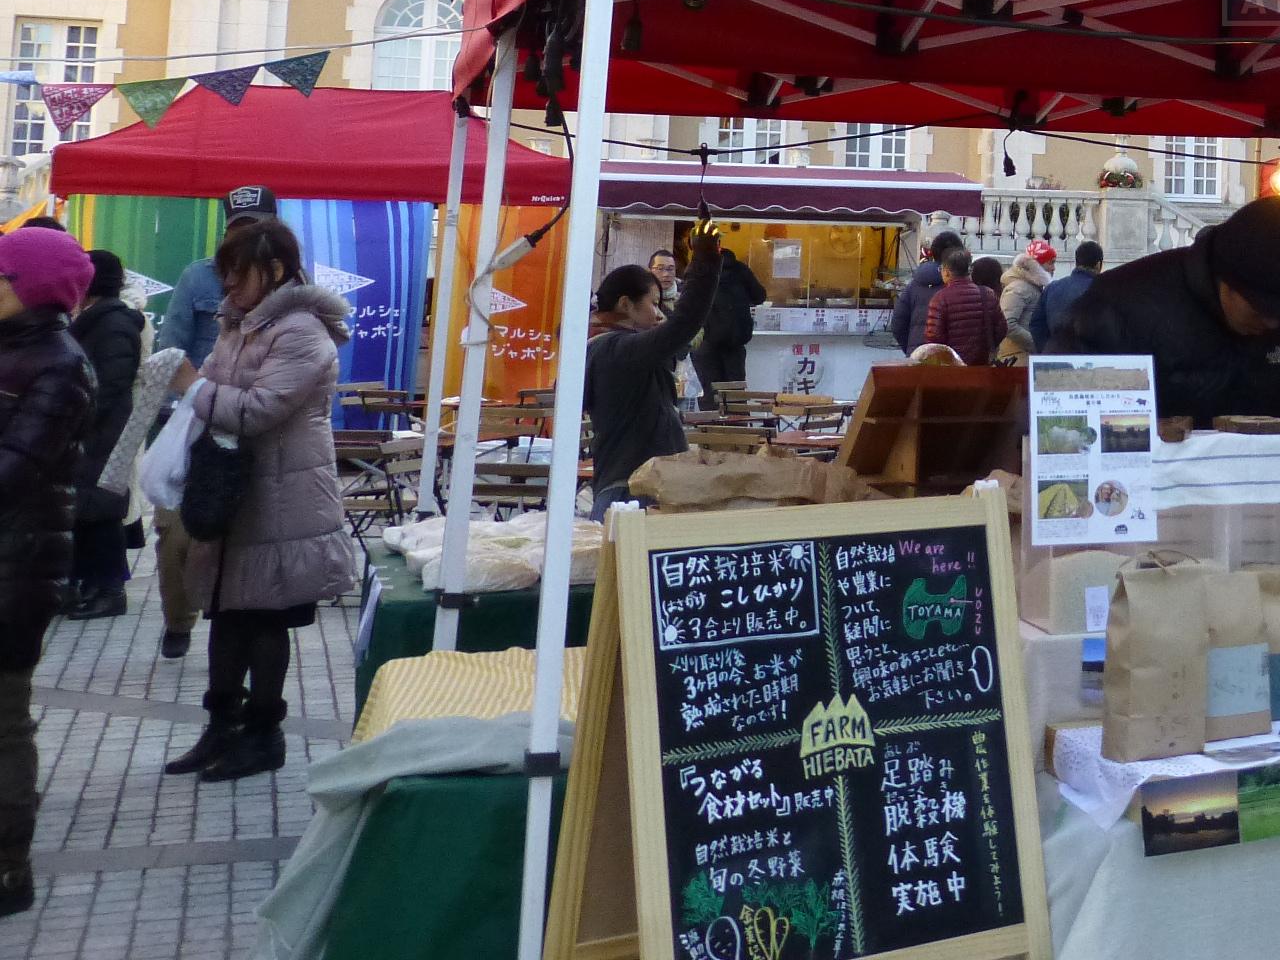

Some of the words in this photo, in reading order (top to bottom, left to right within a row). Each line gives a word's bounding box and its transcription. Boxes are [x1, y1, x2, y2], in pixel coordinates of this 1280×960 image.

[494, 325, 552, 341] マルシェ
[491, 343, 556, 361] ジャポン
[836, 541, 896, 571] 自然栽培
[899, 540, 921, 556] We
[924, 543, 946, 555] are
[661, 549, 785, 588] 自然栽培米
[931, 557, 962, 574] here
[837, 570, 893, 596] や農業に
[907, 604, 962, 621] TOYAMA
[974, 586, 984, 636] UOZU
[810, 715, 867, 747] FARM
[803, 747, 875, 780] HIEBATA
[881, 753, 955, 791] 足踏み
[884, 791, 967, 837] 脱穀機
[695, 826, 792, 866] 自然栽培米と
[887, 830, 962, 875] 体験
[709, 848, 806, 894] 旬の冬野菜
[891, 870, 967, 917] 実施中
